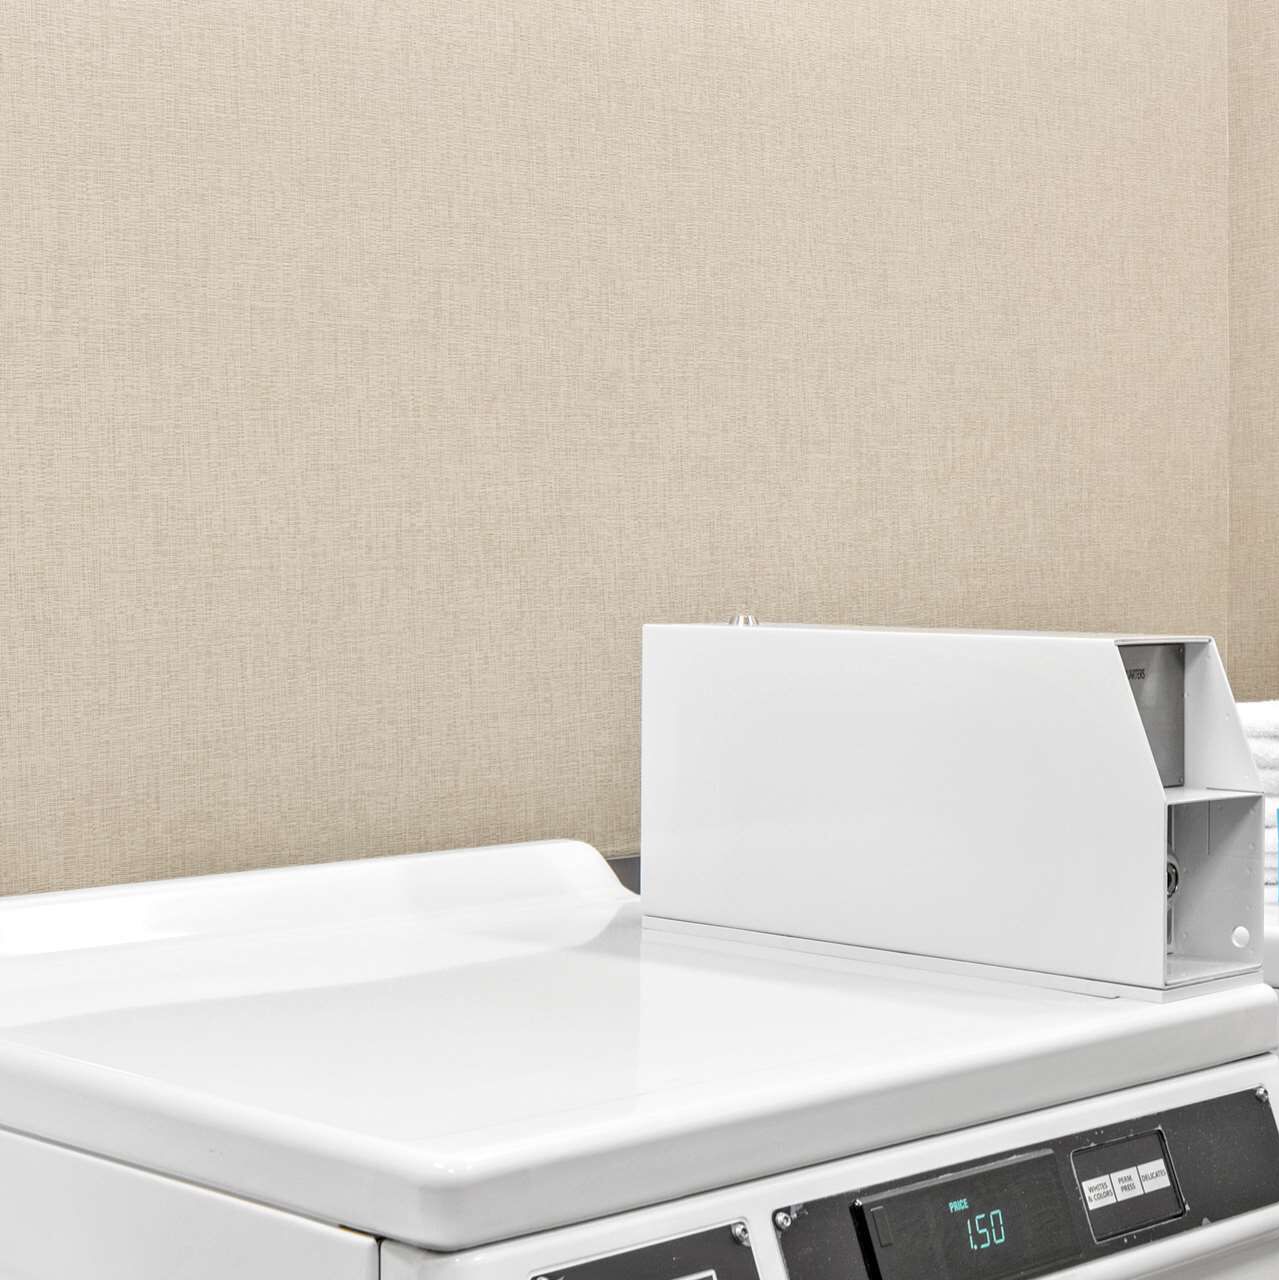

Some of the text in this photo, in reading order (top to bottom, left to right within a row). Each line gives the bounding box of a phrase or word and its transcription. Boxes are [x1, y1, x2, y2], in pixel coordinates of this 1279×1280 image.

[1141, 1168, 1167, 1183] DELICATES
[1087, 1181, 1109, 1194] WHITES
[1093, 1188, 1114, 1201] COLORS
[1120, 1182, 1136, 1193] PRESS
[948, 1198, 969, 1213] PRICE
[967, 1209, 1006, 1250] 1.50
